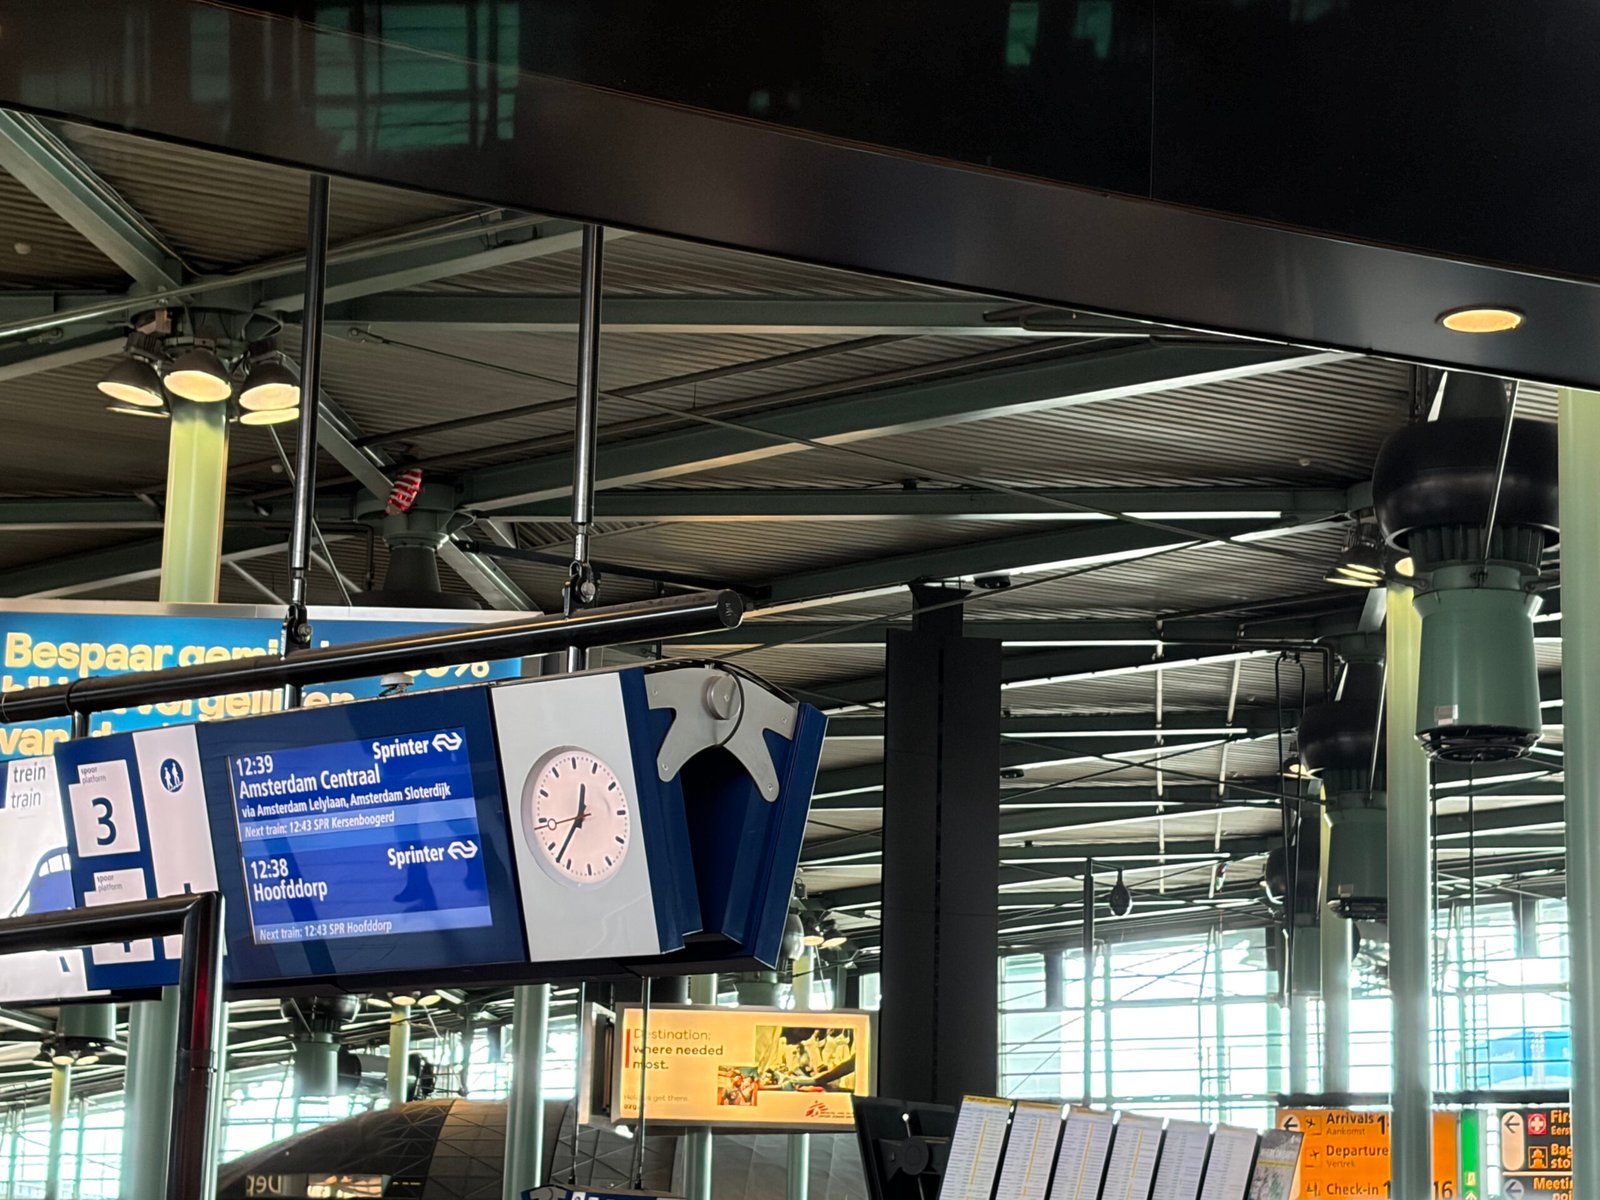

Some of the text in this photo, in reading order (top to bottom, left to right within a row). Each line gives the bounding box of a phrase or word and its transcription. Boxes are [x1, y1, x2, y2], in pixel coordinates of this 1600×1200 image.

[4, 632, 173, 678] Bespaar
[372, 738, 429, 763] Sprinter
[13, 762, 46, 783] trein
[81, 767, 98, 777] spoor
[236, 755, 273, 777] 12:39
[82, 776, 107, 785] platform
[239, 763, 381, 799] Amsterdam Centraal
[11, 788, 42, 809] train
[242, 783, 451, 818] via Amsterdam Lelylaan, Amsterdam Sloterdijk
[91, 796, 117, 846] 3
[245, 810, 395, 838] Next train: 12:43 SPR Kersenboogerd
[387, 846, 445, 870] Sprinter
[96, 874, 114, 884] spoor
[251, 858, 289, 880] 12:38
[98, 883, 123, 893] platform
[253, 878, 328, 902] Hoofddorp
[260, 919, 392, 941] Next train: 12:43 SPR Hoofddorp
[633, 1028, 711, 1041] Dstination:
[675, 1044, 724, 1056] needed
[1326, 1112, 1374, 1124] Arrivals
[1550, 1110, 1571, 1124] Fir
[1326, 1128, 1366, 1136] Aankomst
[1326, 1145, 1389, 1158] Departure
[1326, 1160, 1355, 1168] Vertrek
[1326, 1183, 1379, 1195] Check-in
